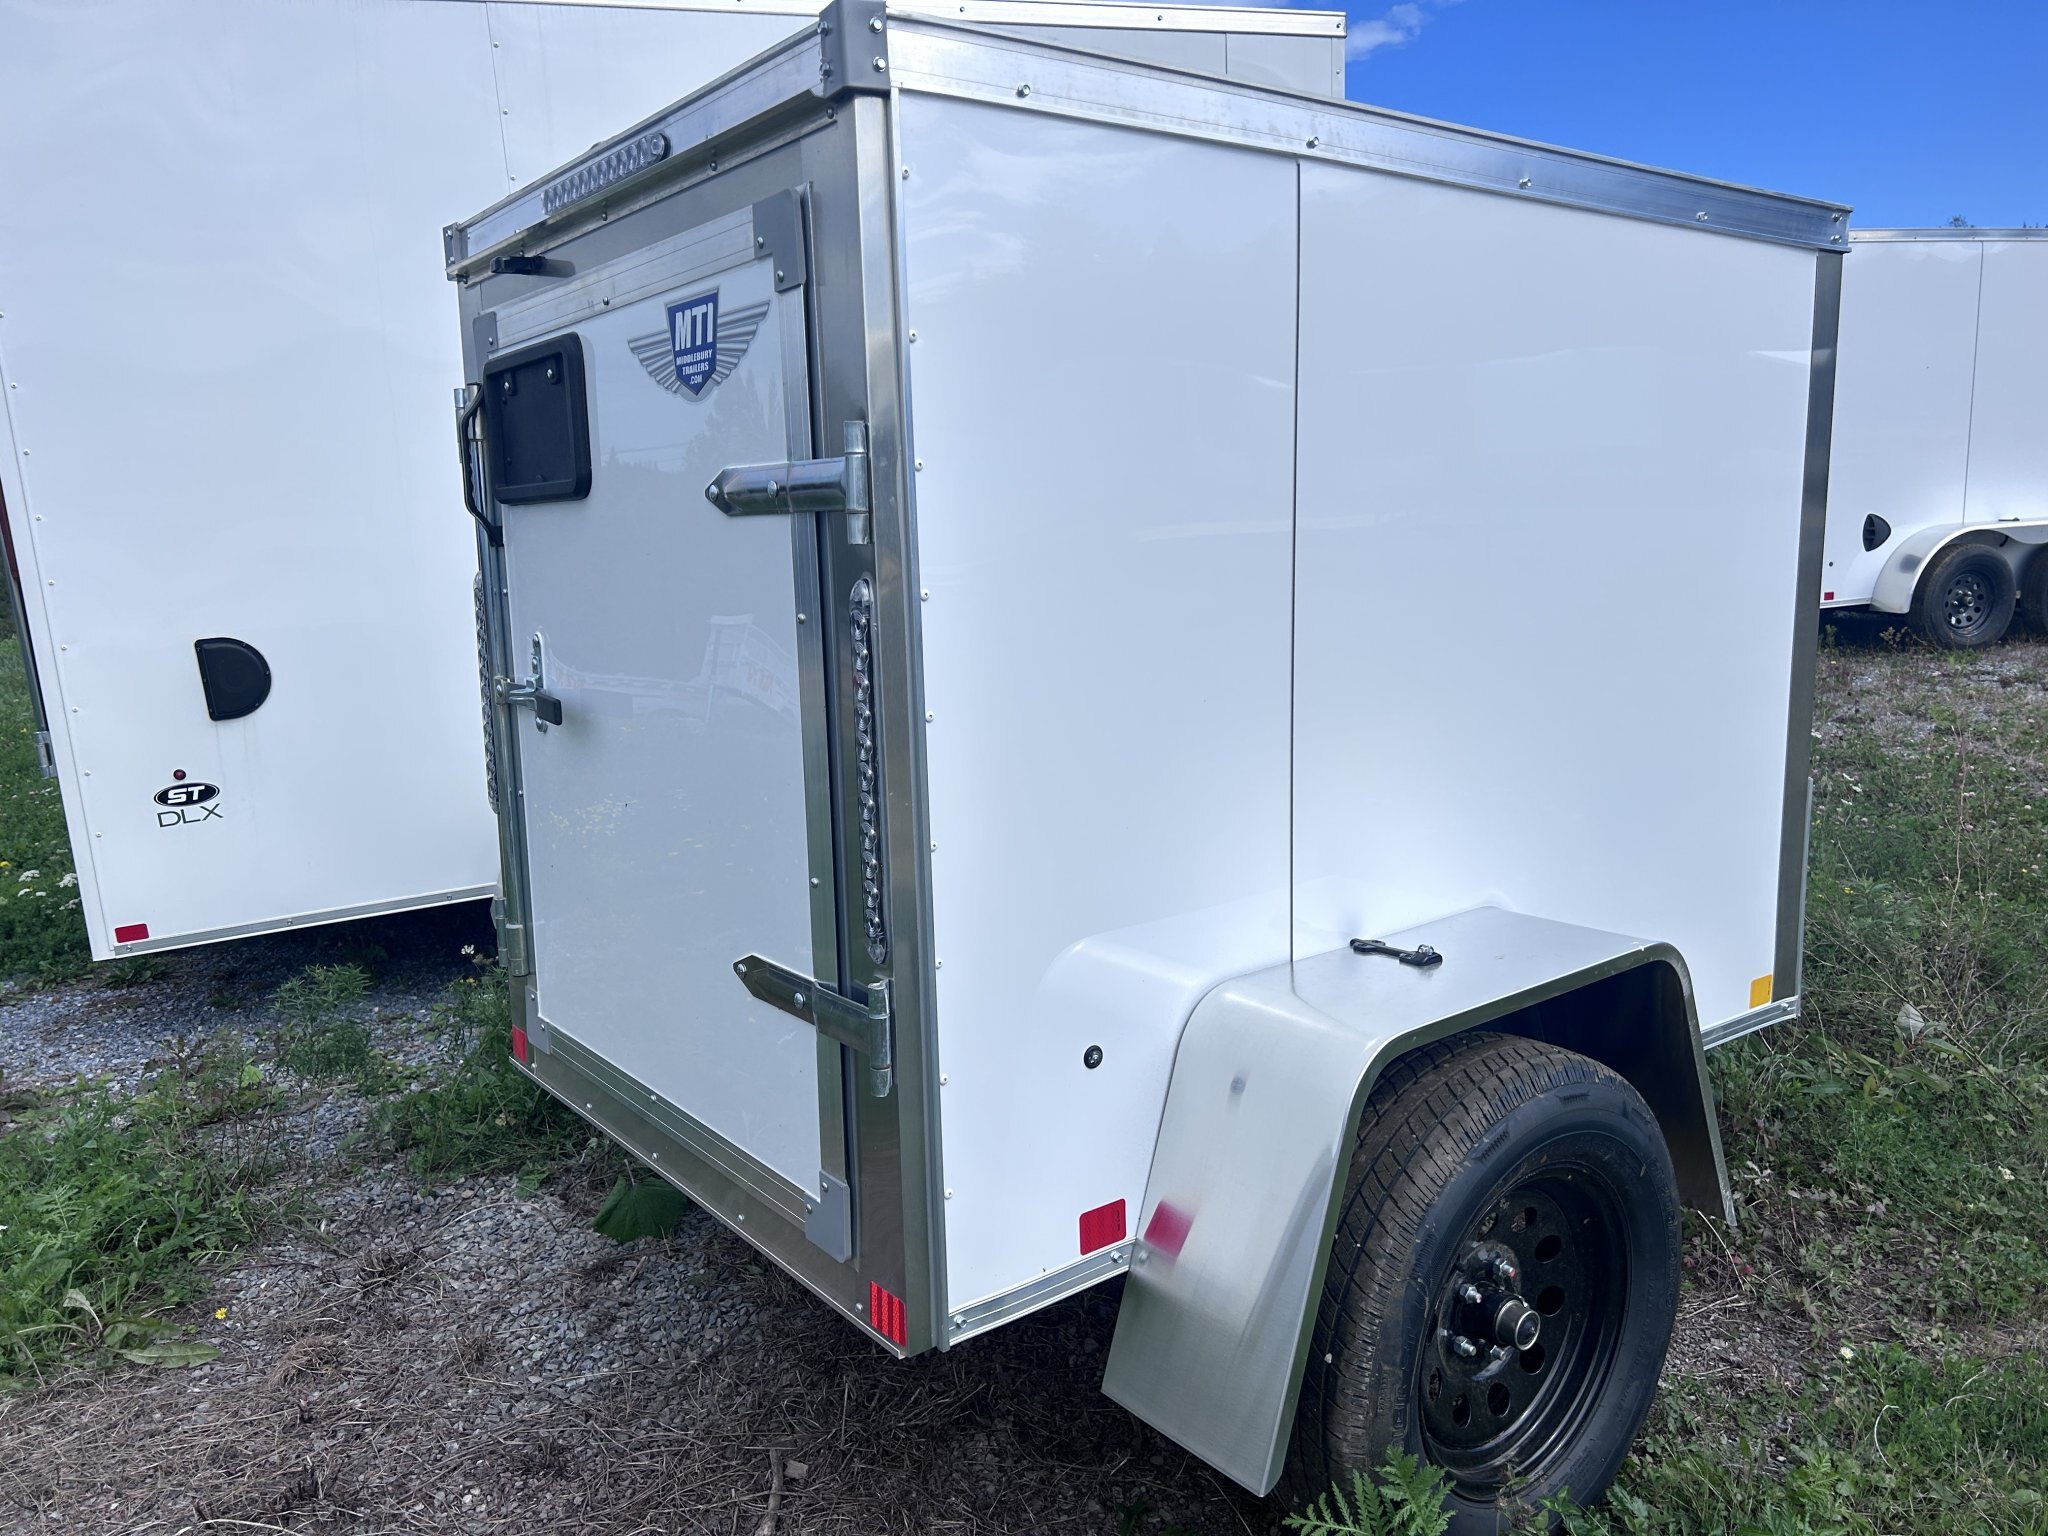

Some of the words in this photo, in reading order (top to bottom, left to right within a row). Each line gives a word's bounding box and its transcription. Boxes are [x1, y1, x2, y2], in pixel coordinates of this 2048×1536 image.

[675, 302, 714, 351] MTI
[676, 349, 713, 366] MIDDLEBURY
[682, 361, 709, 376] TRAILERS
[690, 374, 703, 385] .COM
[167, 785, 206, 804] ST
[157, 803, 224, 828] DLX
